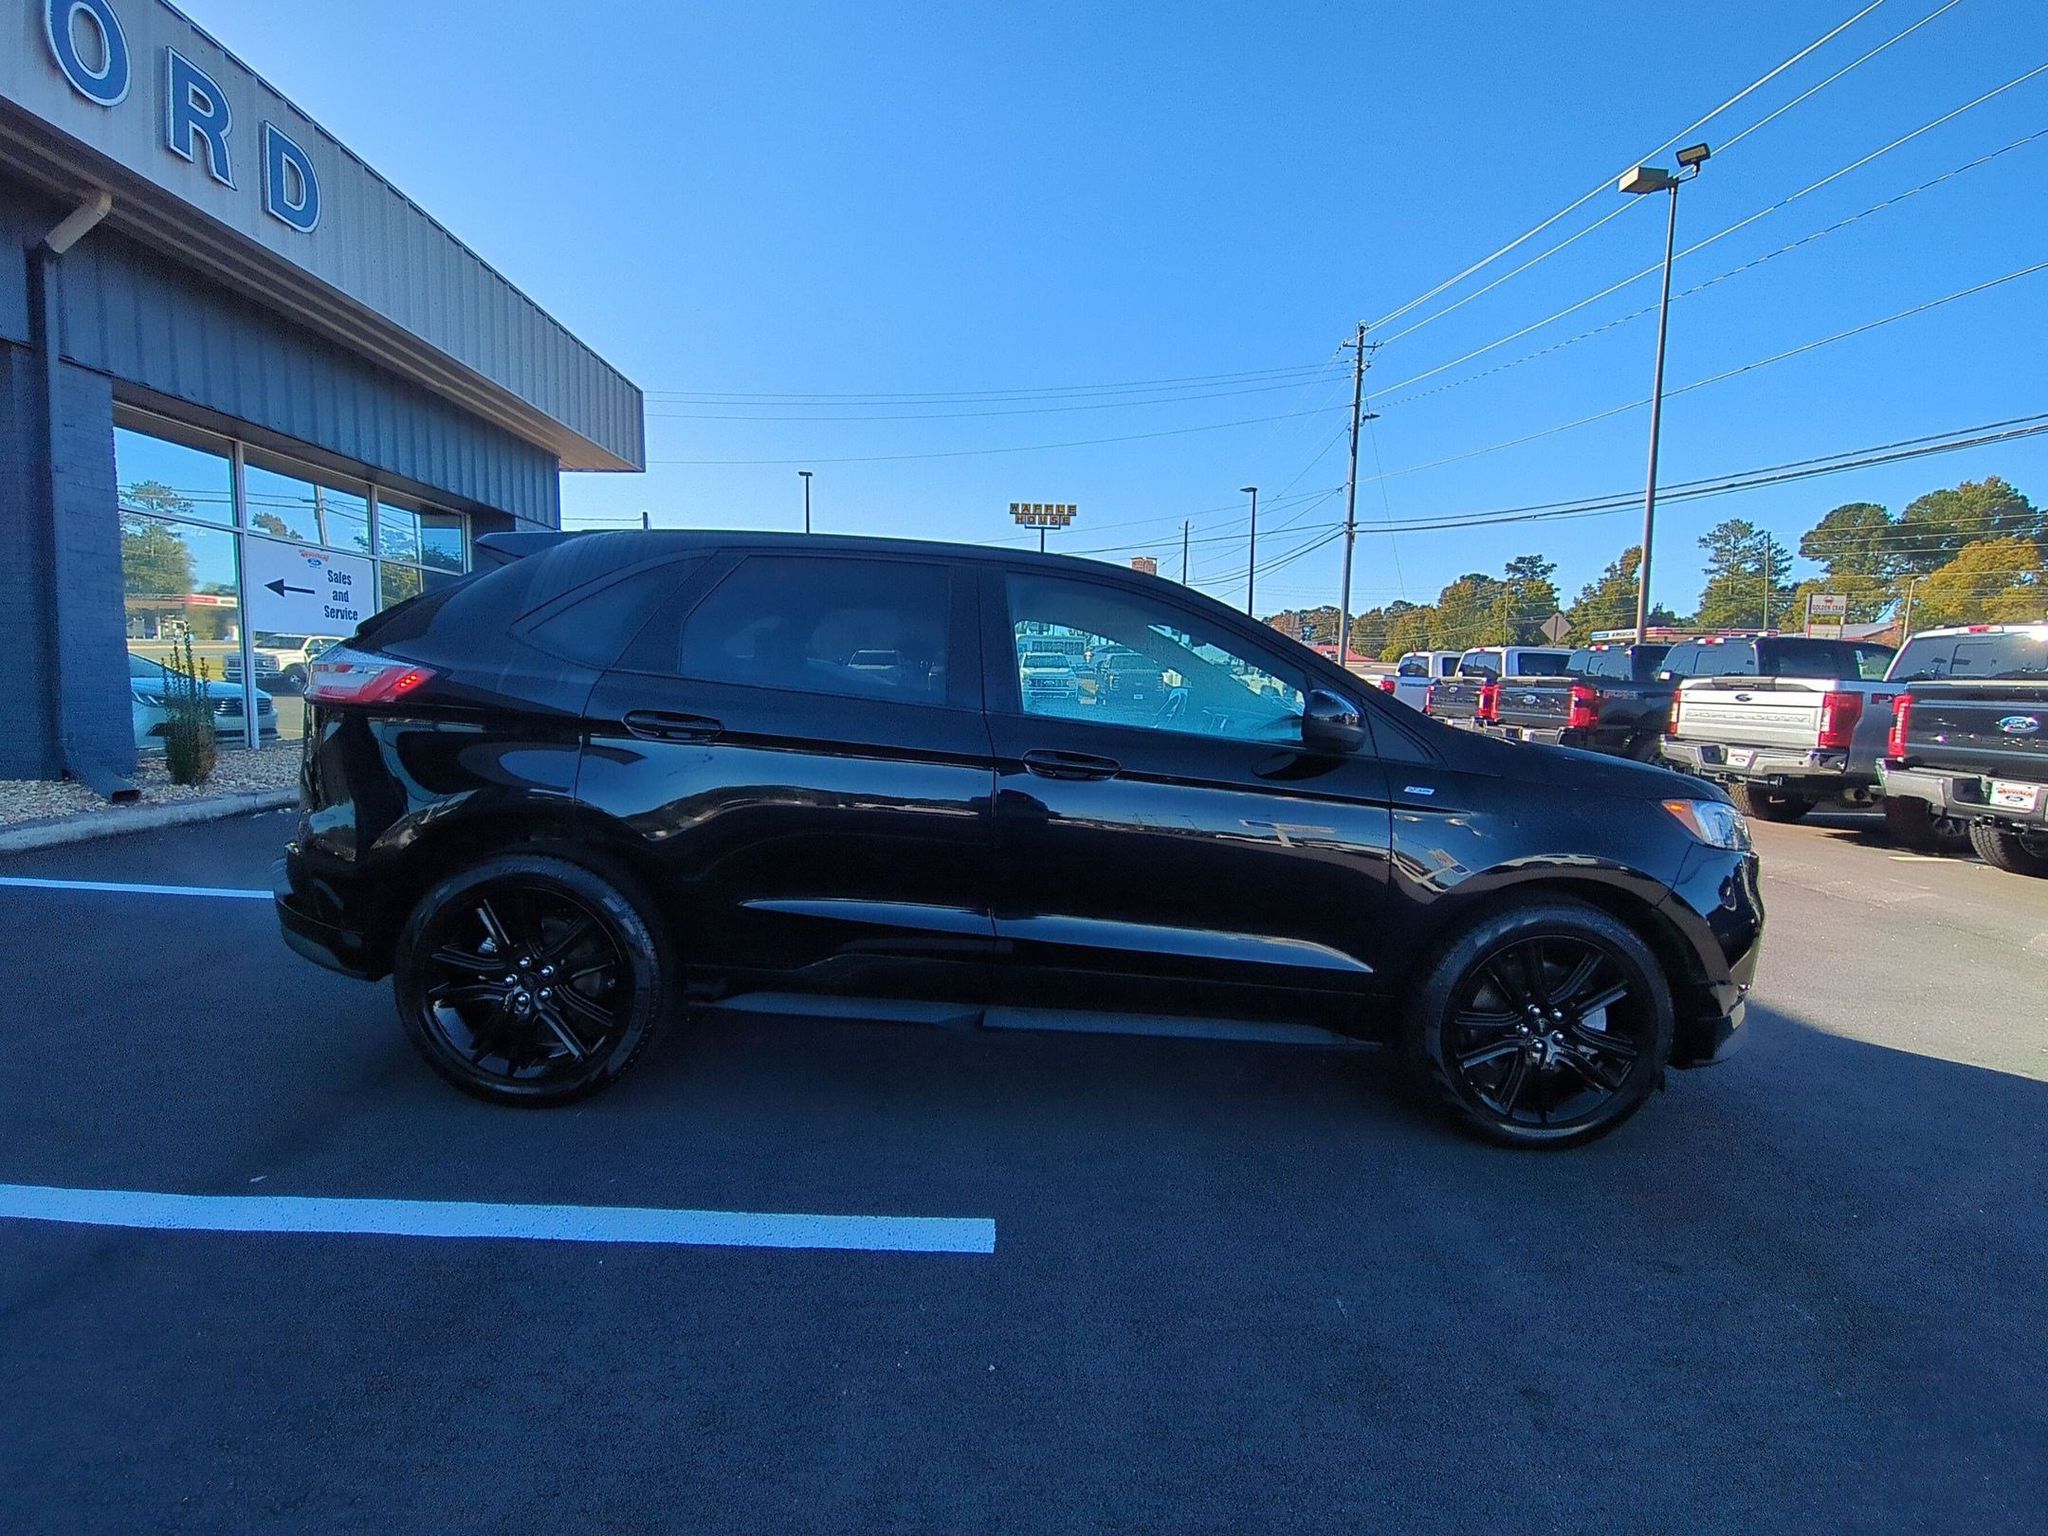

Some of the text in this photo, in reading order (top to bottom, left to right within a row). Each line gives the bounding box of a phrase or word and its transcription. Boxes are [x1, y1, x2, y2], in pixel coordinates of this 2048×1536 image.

[1010, 503, 1076, 515] WAFFLE
[1016, 515, 1070, 524] HOUSE
[327, 569, 352, 586] Sales
[332, 590, 350, 603] and
[324, 605, 358, 621] Service
